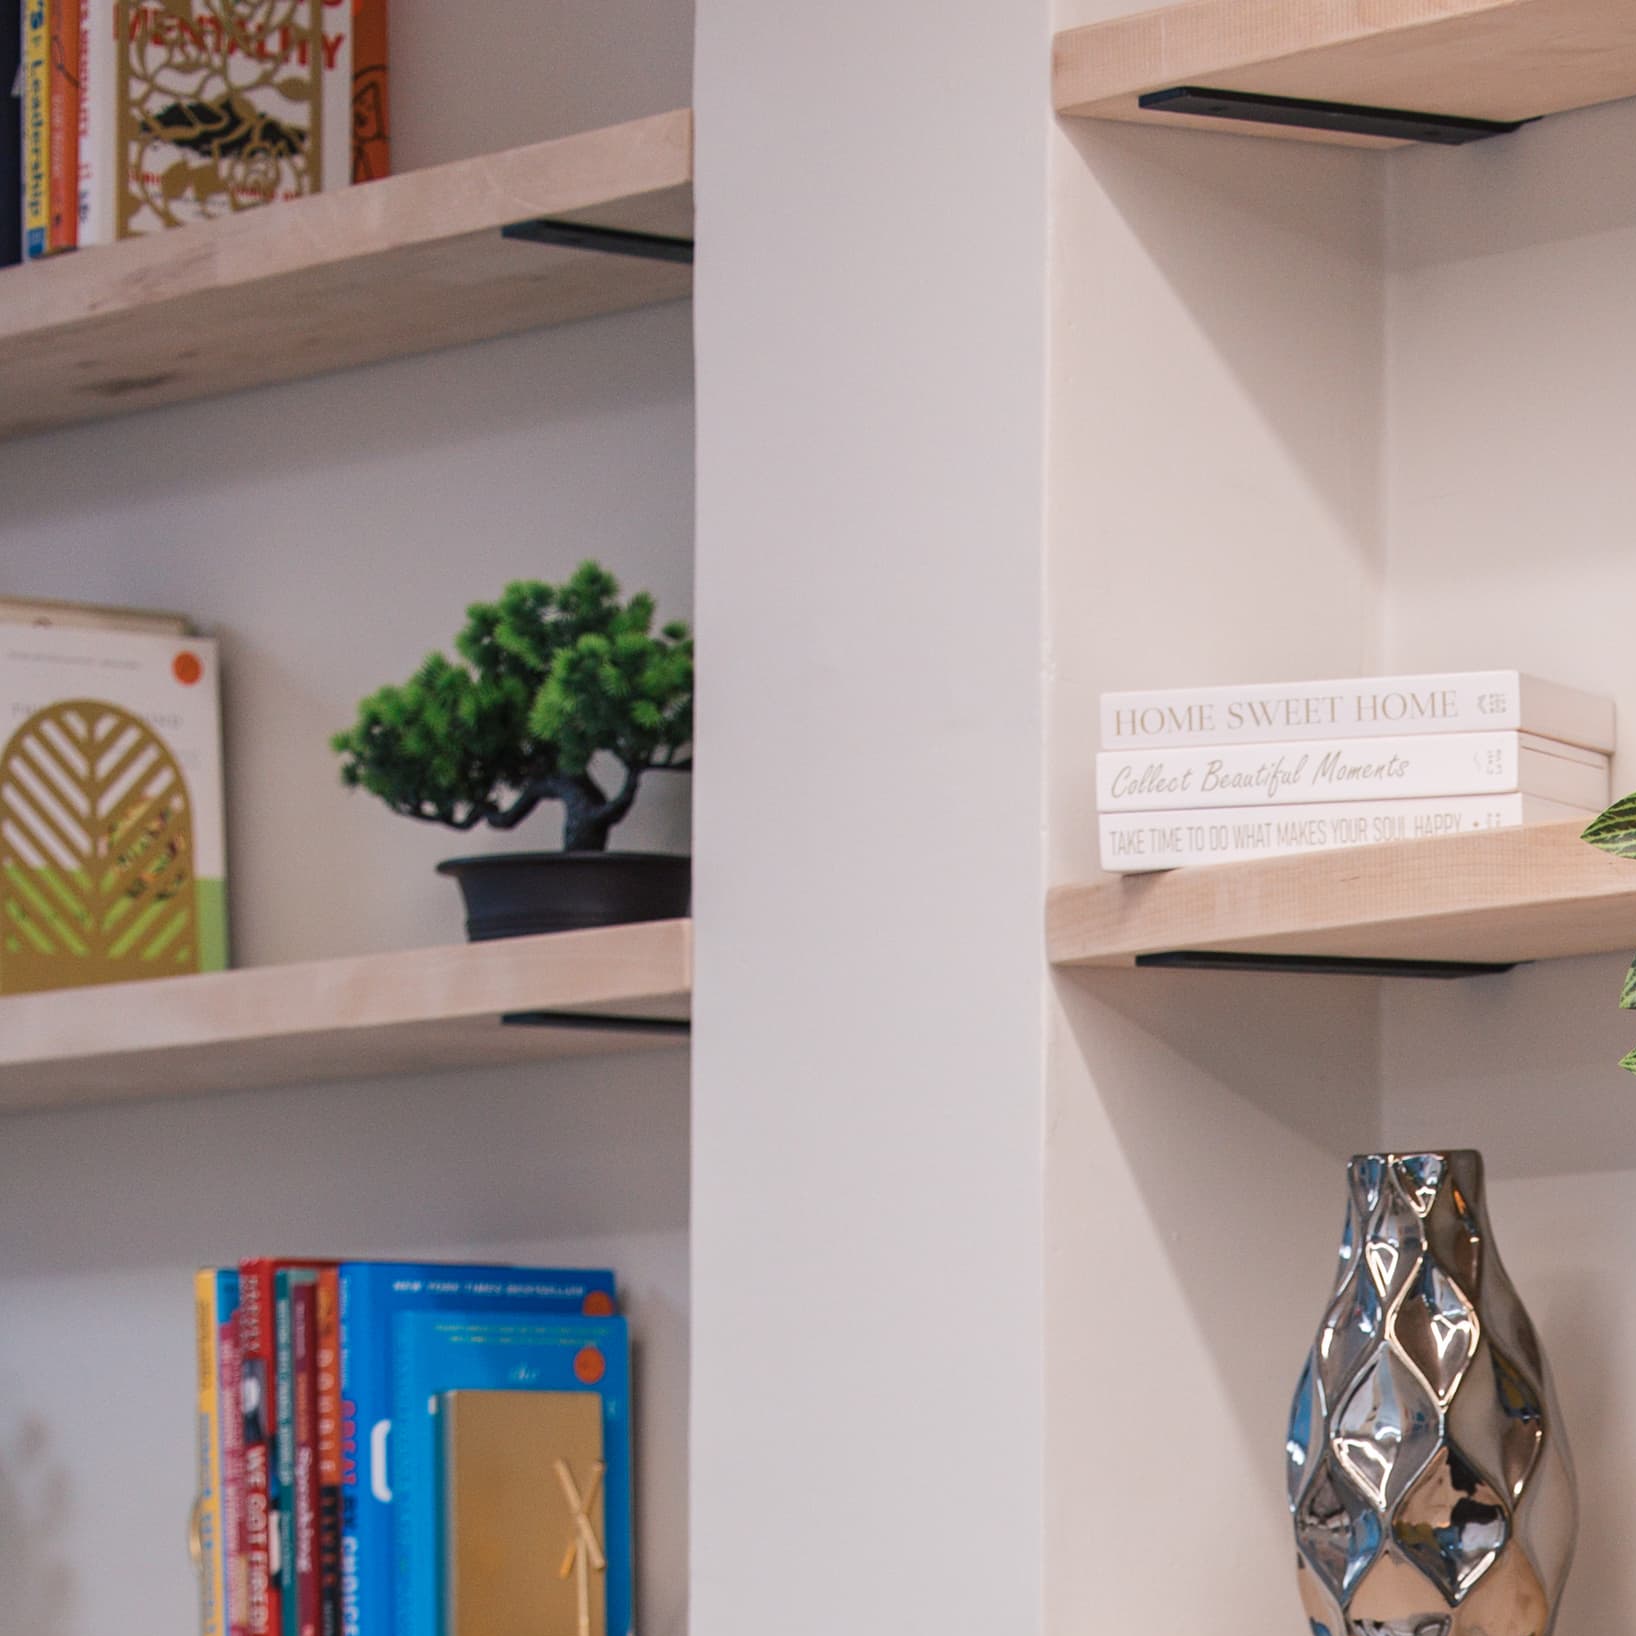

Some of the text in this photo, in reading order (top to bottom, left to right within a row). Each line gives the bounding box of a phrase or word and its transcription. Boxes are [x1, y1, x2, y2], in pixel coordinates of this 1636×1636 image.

[1114, 703, 1216, 737] HOME
[1227, 696, 1343, 730] SWEET
[1355, 690, 1459, 722] HOME
[1111, 750, 1410, 799] Collect Beautiful Moments
[1109, 829, 1146, 856] TAKE
[1150, 827, 1183, 853] TIME
[1186, 825, 1205, 851] TO
[1209, 825, 1229, 851] DO
[1232, 822, 1273, 849] WHAT
[1277, 819, 1328, 847] MAKES
[1330, 817, 1368, 844] YOUR
[1373, 815, 1406, 842] SOUL
[1414, 813, 1462, 837] HAPPY
[247, 1493, 269, 1547] GOT
